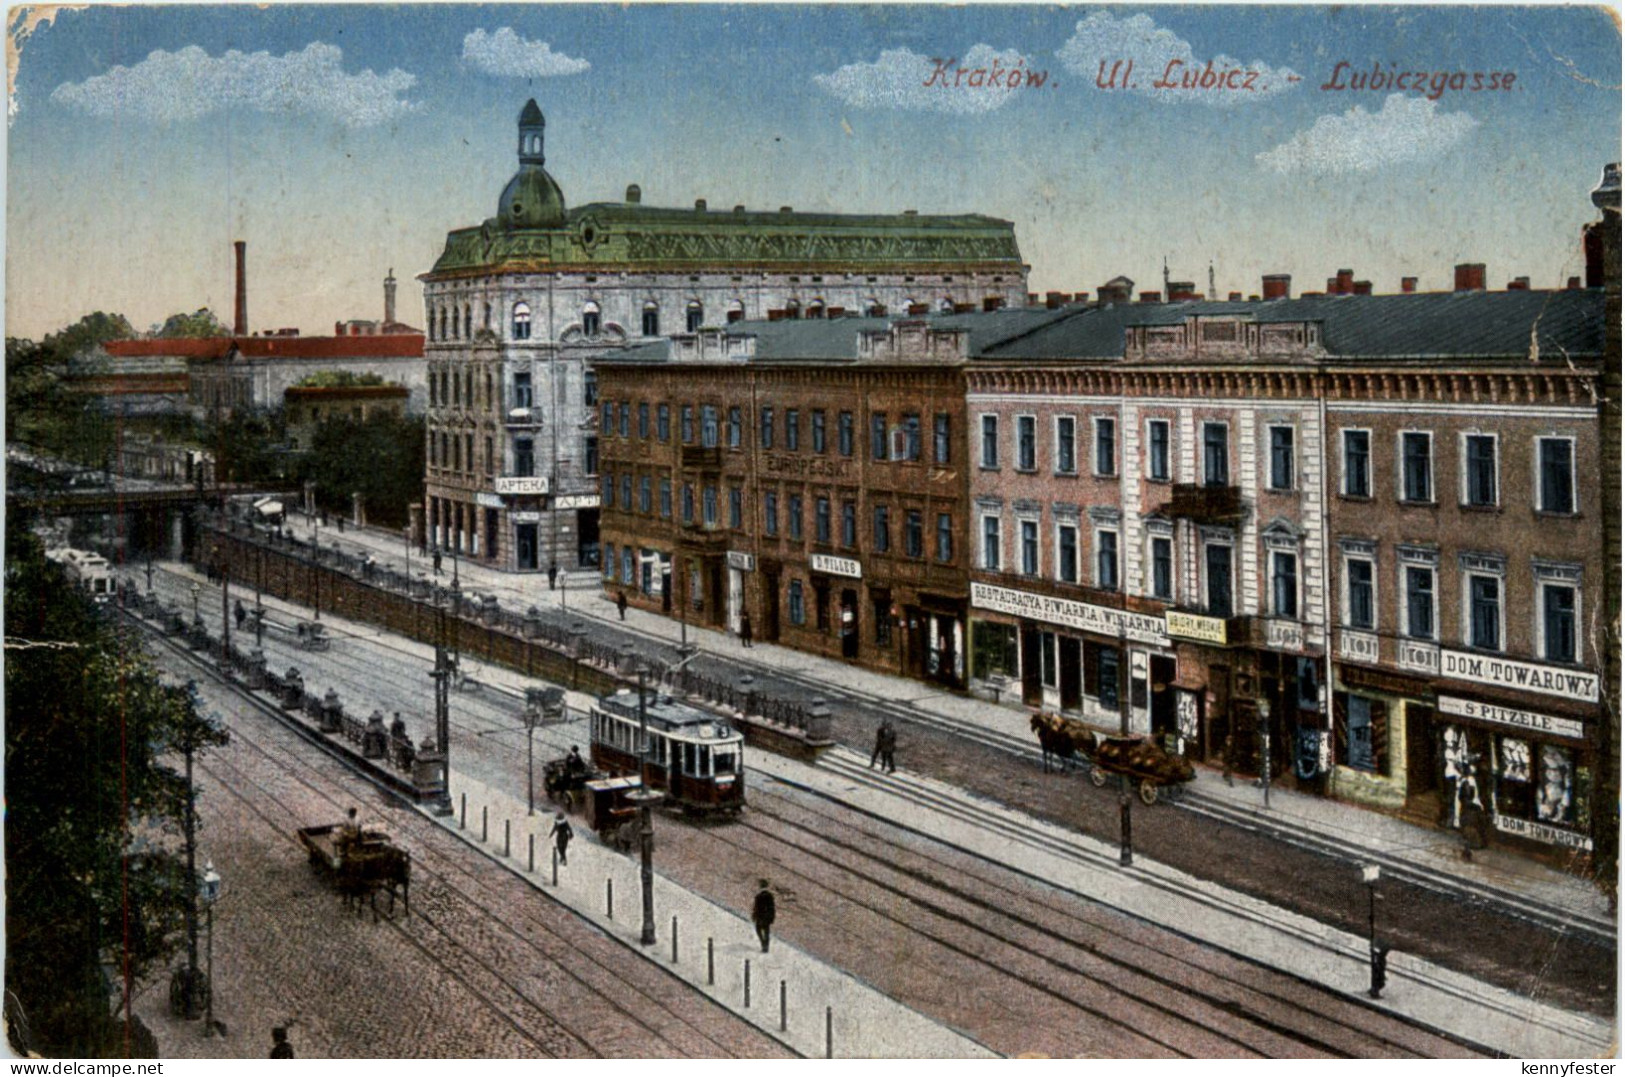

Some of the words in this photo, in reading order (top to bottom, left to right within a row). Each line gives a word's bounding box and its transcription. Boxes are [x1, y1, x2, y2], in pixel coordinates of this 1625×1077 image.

[501, 480, 546, 492] APTEKA
[1446, 655, 1483, 678] DOM
[1491, 662, 1594, 697] TOWAROWY
[1481, 705, 1552, 730] PITZELE
[1502, 816, 1525, 832] DOM
